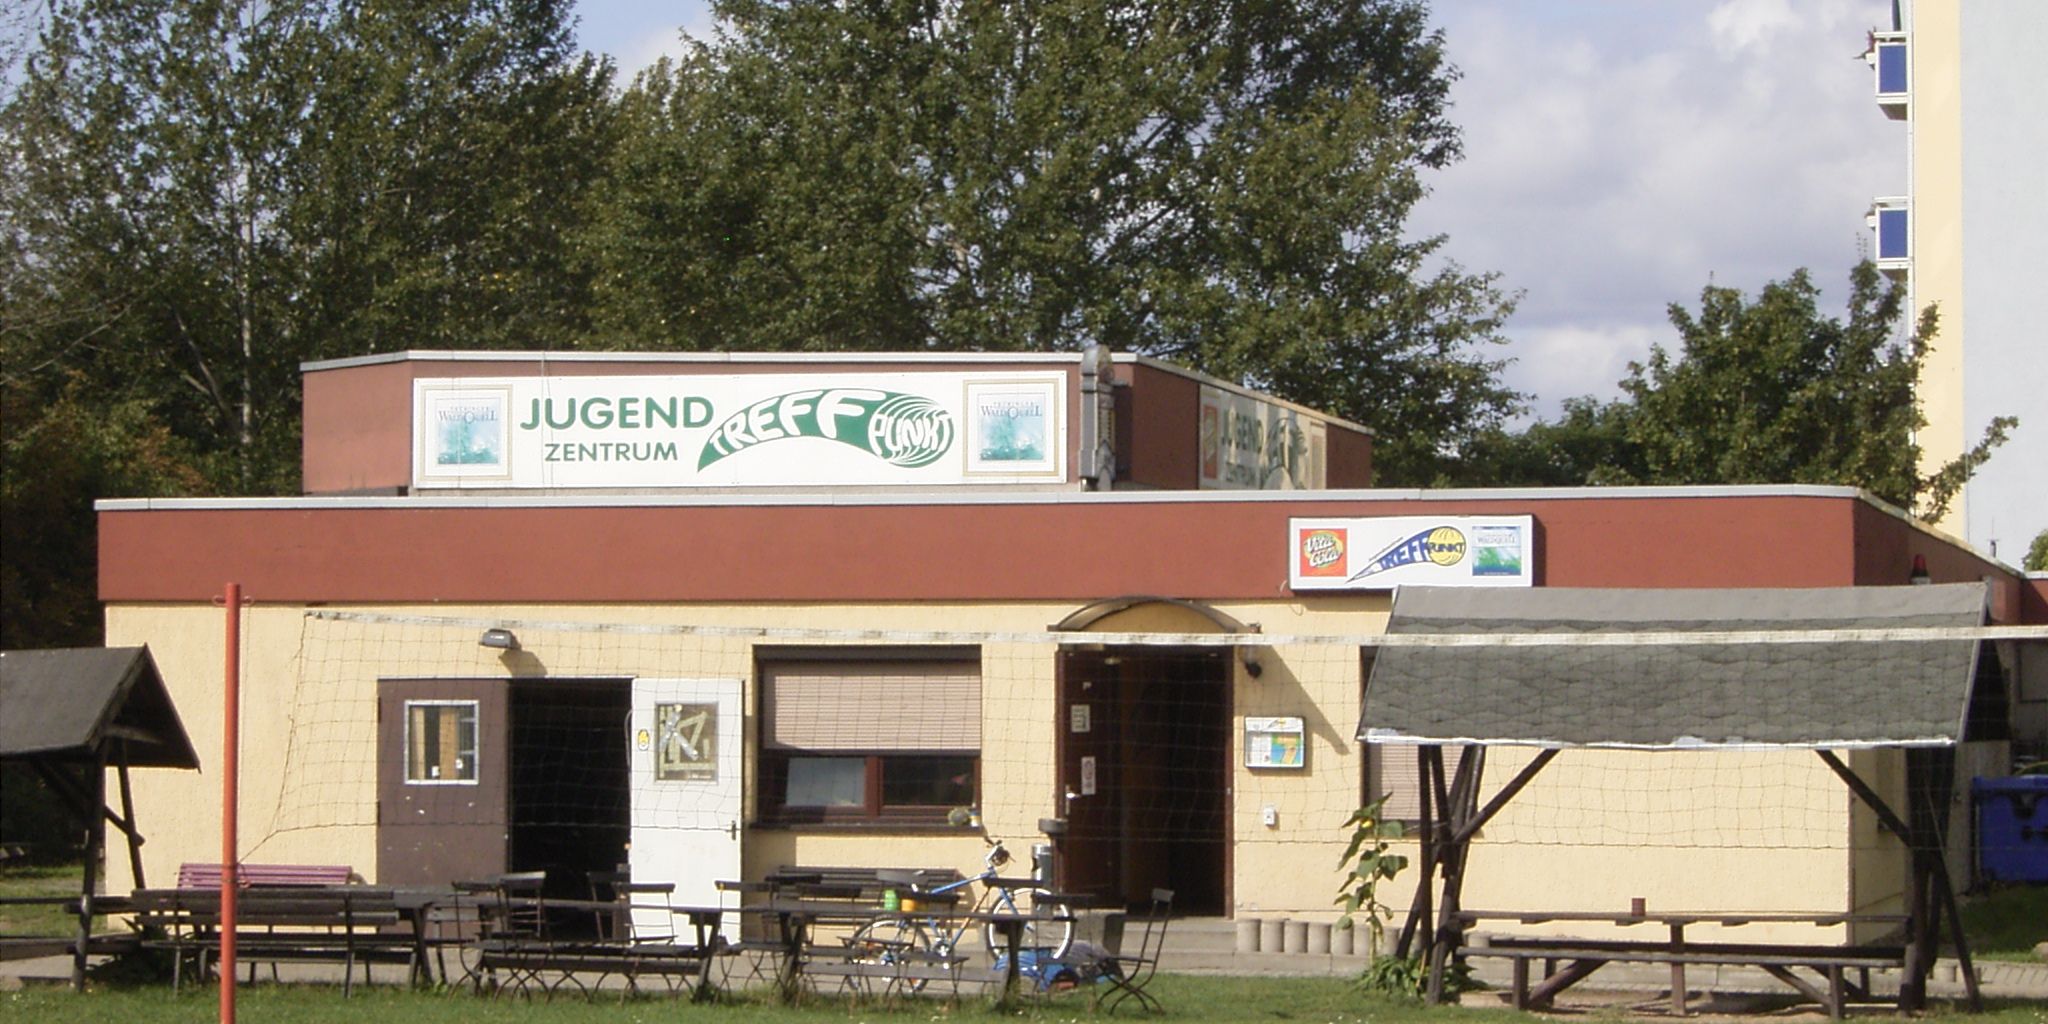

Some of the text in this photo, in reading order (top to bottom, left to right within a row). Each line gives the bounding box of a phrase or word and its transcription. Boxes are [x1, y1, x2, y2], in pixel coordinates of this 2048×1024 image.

[520, 396, 713, 430] JUGEND
[708, 389, 951, 457] TREFF PUNKT
[544, 441, 678, 462] ZENTRUM
[1425, 541, 1464, 554] PUNKT
